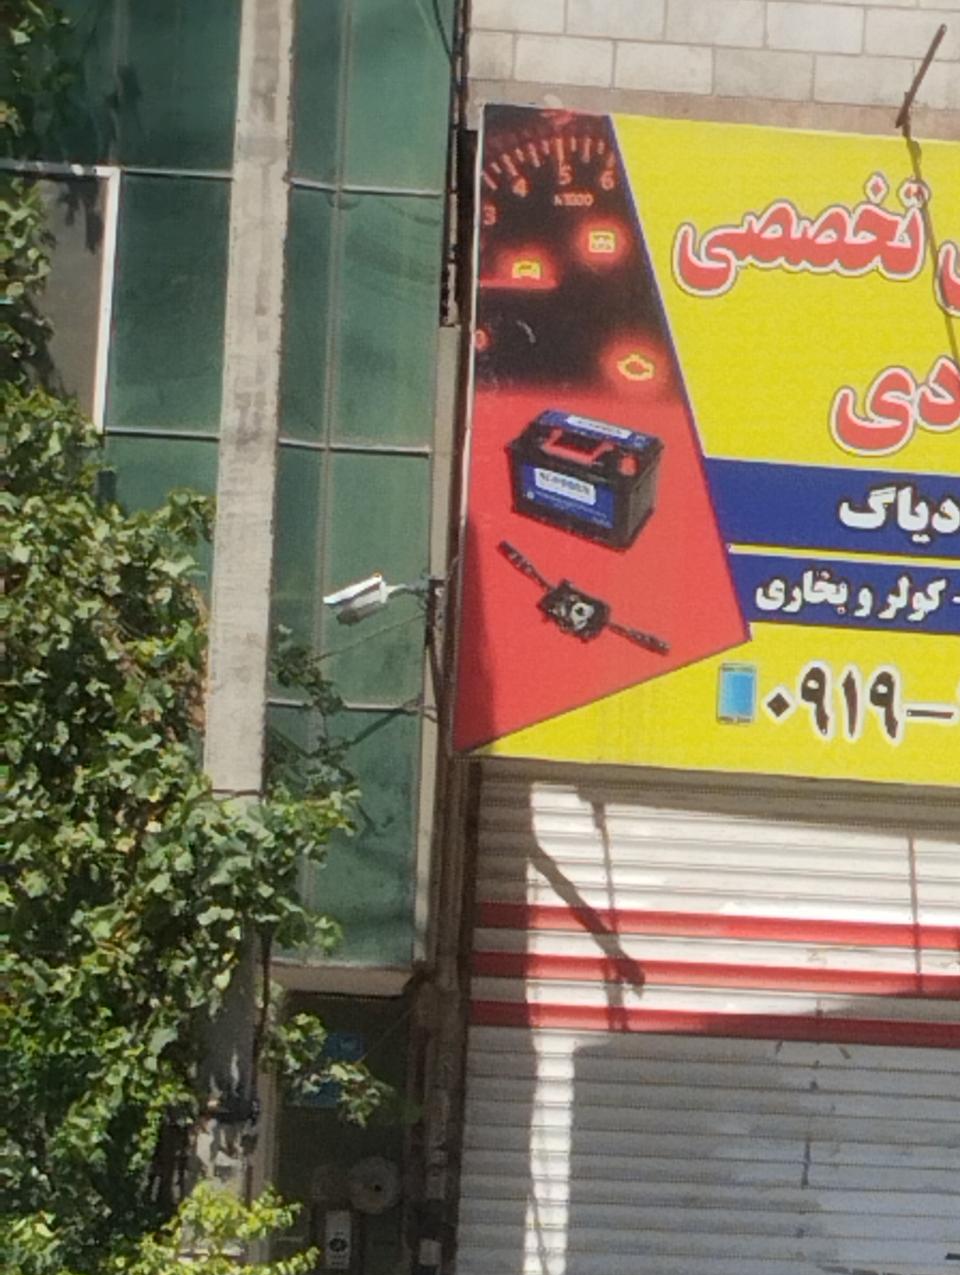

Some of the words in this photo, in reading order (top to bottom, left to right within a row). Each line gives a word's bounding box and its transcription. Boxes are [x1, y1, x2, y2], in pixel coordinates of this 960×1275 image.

[673, 172, 929, 296] تخصصی
[838, 486, 960, 543] دیاگ
[755, 569, 849, 615] بخاری
[854, 587, 873, 618] و
[877, 576, 947, 621] کولر
